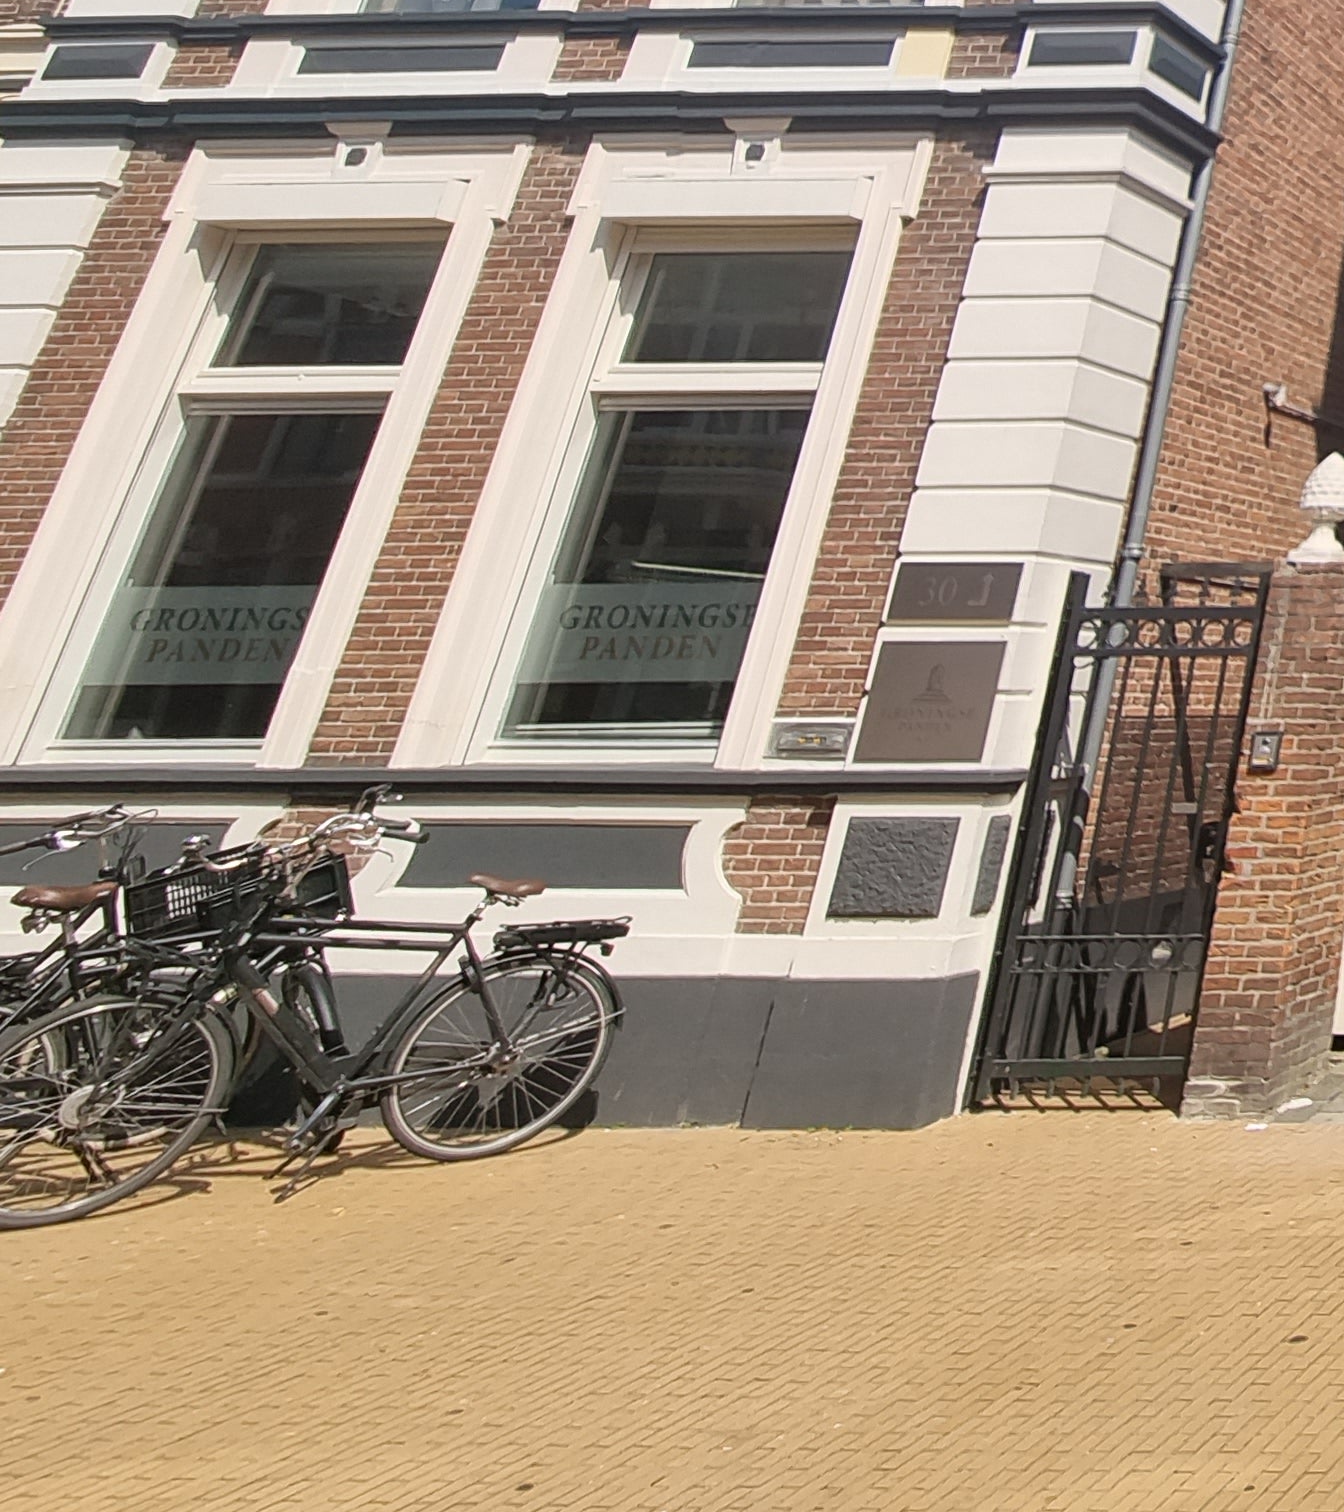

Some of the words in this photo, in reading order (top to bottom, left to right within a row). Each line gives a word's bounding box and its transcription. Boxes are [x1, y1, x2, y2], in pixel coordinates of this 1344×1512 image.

[918, 576, 957, 606] 30
[145, 638, 289, 662] PANDEN
[579, 636, 722, 660] PANDEN
